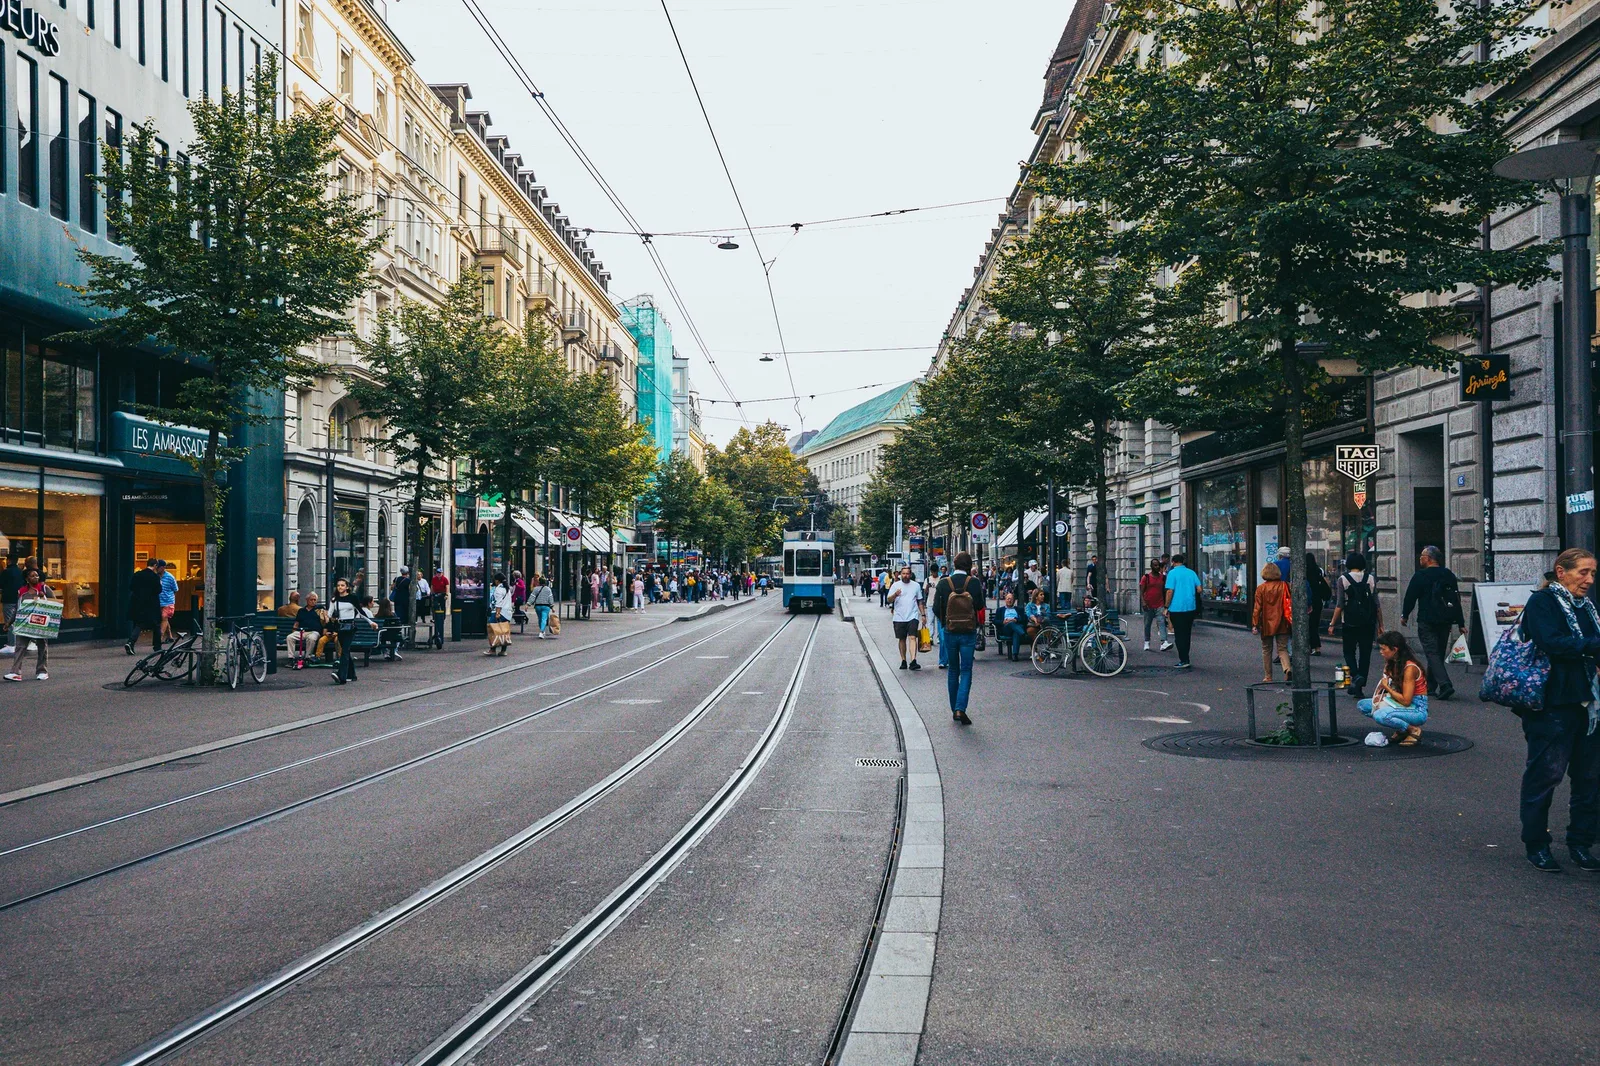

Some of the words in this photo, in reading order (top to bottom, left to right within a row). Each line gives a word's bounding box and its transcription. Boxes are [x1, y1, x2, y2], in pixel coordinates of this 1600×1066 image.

[1465, 369, 1507, 395] Sprüngli
[132, 427, 149, 450] LES
[1340, 447, 1376, 459] TAG
[1339, 461, 1377, 478] HEUER
[1354, 482, 1366, 492] TAG
[805, 532, 812, 540] 7
